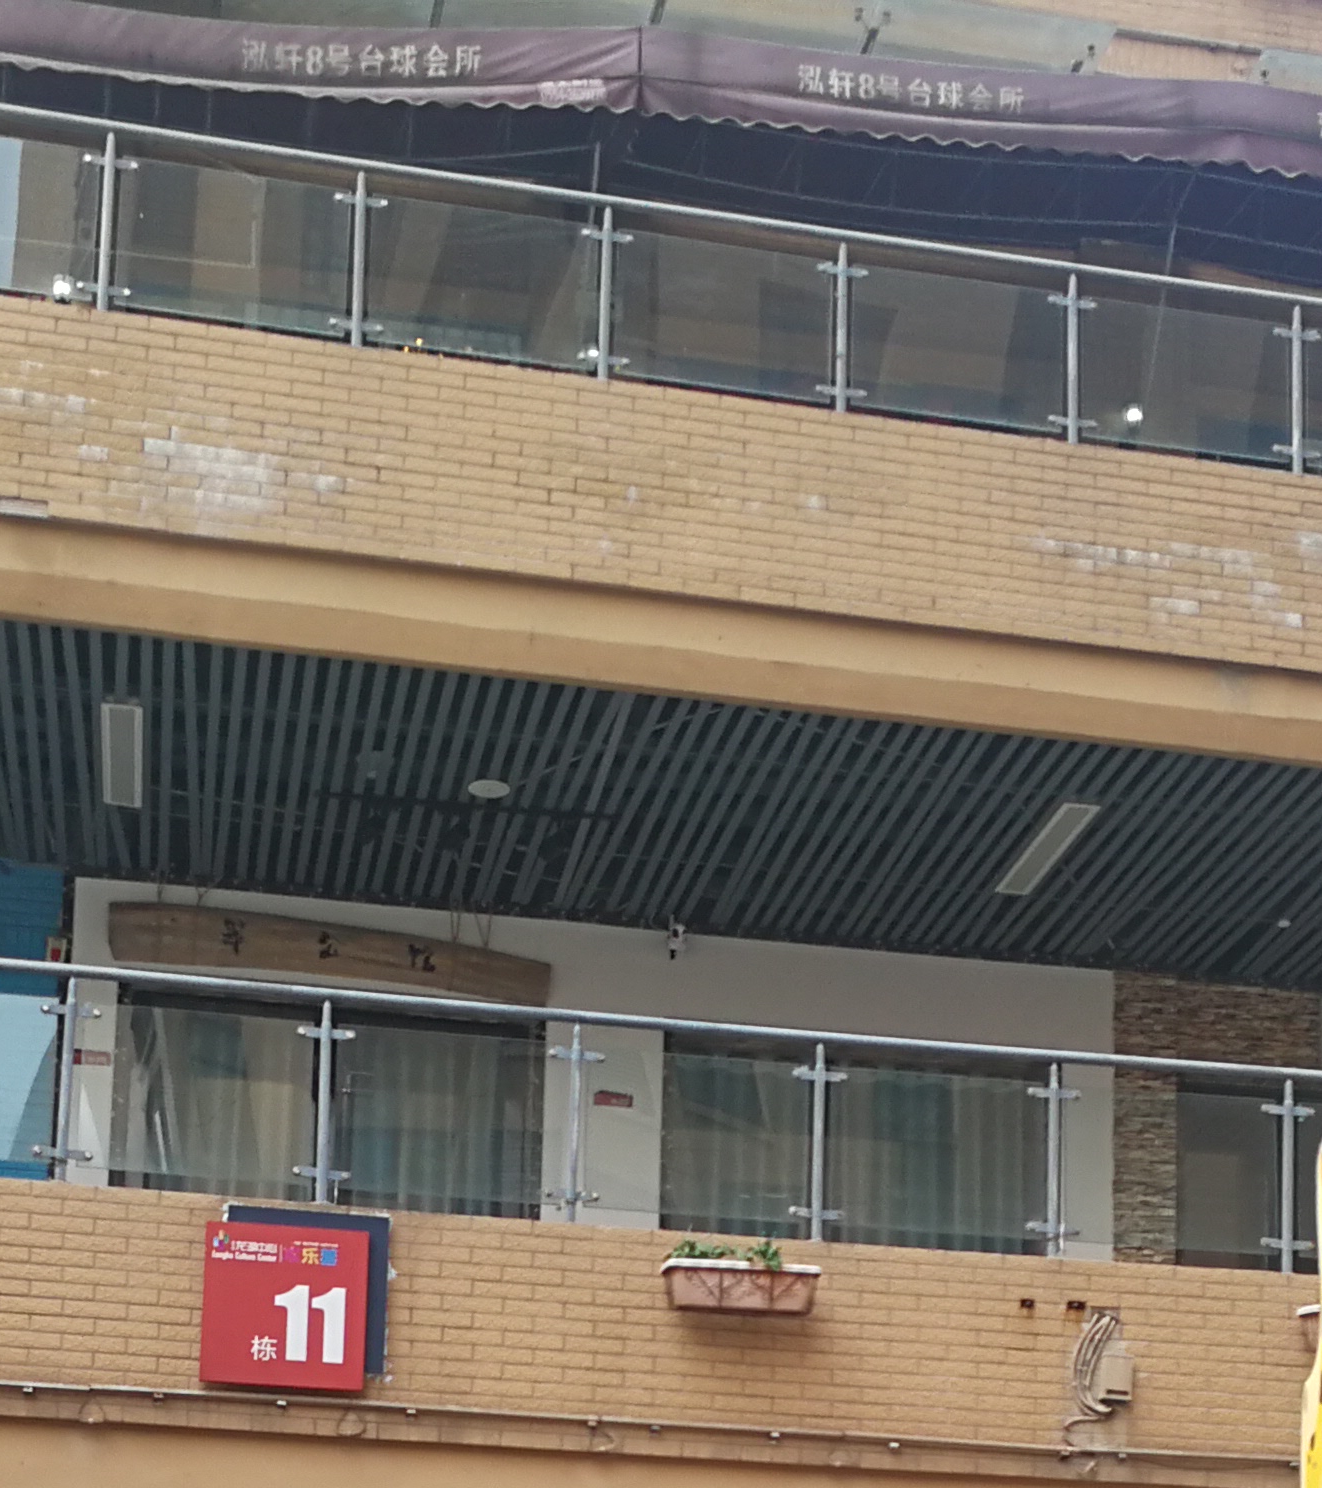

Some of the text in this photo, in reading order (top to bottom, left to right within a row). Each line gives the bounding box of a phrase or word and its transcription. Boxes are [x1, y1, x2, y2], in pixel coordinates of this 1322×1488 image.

[797, 63, 1026, 115] 泓轩8号台球会所
[250, 1335, 278, 1362] 栋
[274, 1284, 348, 1364] 11
